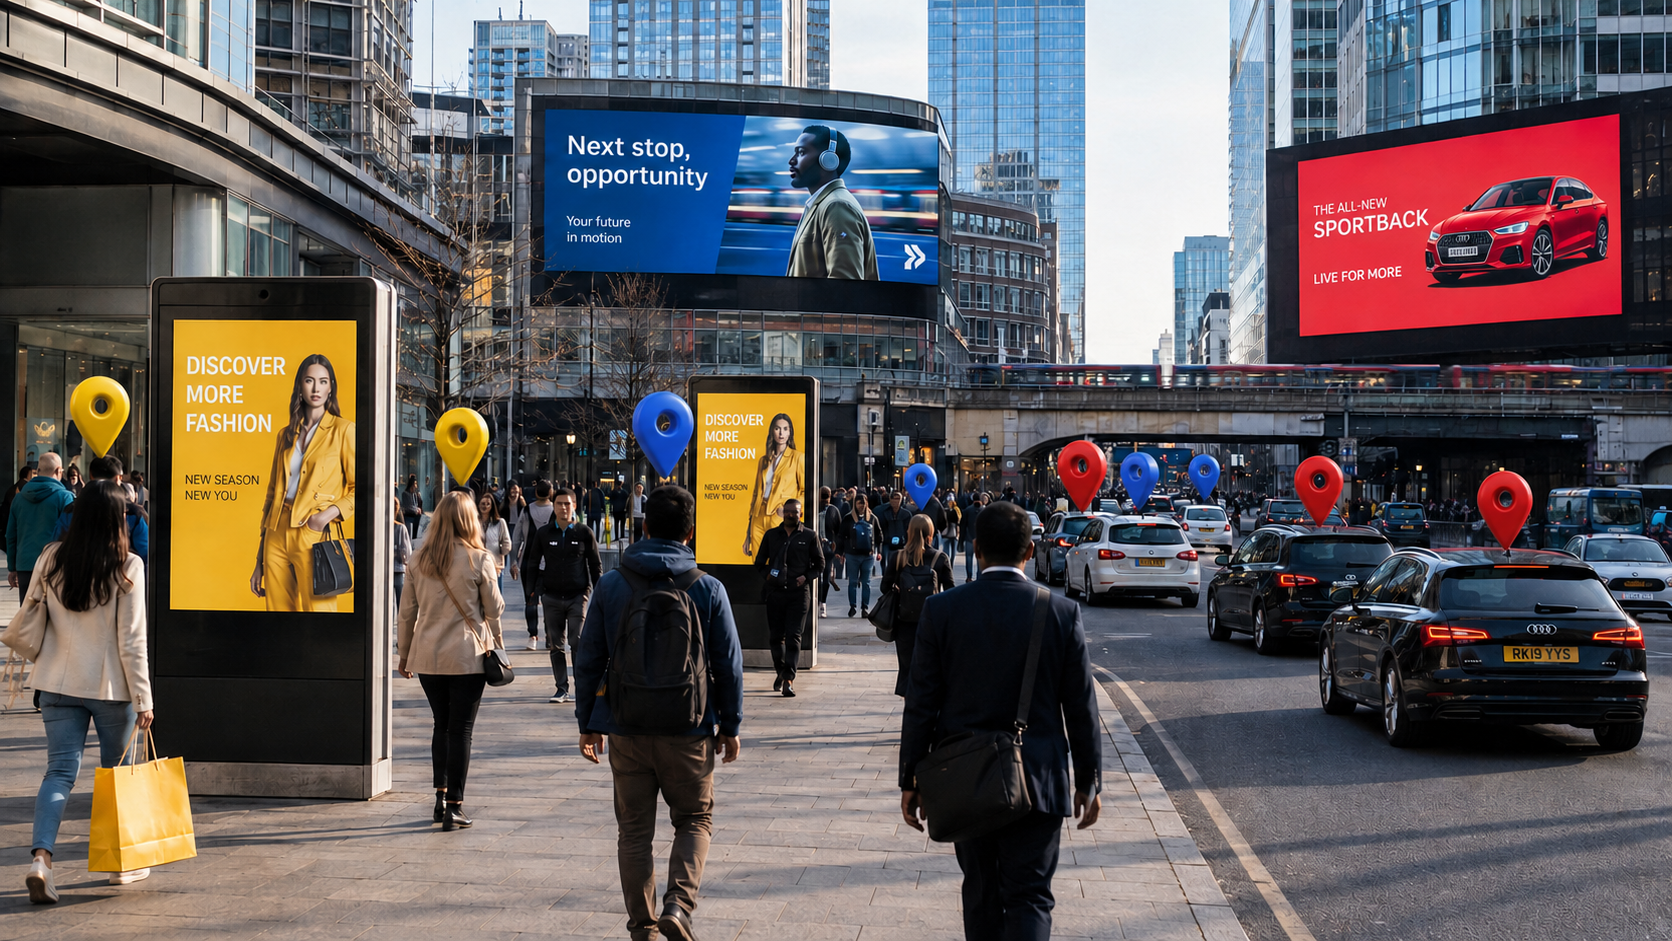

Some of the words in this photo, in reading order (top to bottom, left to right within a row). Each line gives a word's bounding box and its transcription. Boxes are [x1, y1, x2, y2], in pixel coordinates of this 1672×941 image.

[568, 135, 624, 157] Next
[631, 139, 690, 163] stop,
[567, 166, 709, 192] opportunity
[1313, 203, 1335, 216] THE
[1337, 197, 1389, 214] ALL-NEW
[566, 215, 594, 228] Your
[596, 216, 631, 228] future
[1313, 208, 1430, 239] SPORTBACK
[567, 231, 578, 243] in
[581, 232, 622, 244] motion
[1313, 272, 1339, 285] LIVE
[1342, 269, 1365, 282] FOR
[1368, 266, 1403, 280] MORE
[186, 356, 286, 376] DISCOVER
[186, 385, 244, 404] MORE
[186, 414, 272, 433] FASHION
[705, 413, 764, 426] DISCOVER
[705, 430, 739, 443] MORE
[704, 447, 756, 460] FASHION
[185, 474, 212, 486] NEW
[214, 474, 260, 486] SEASON
[704, 483, 720, 491] NEW
[720, 483, 748, 491] SEASON
[185, 490, 212, 502] NEW
[214, 490, 238, 502] YOU
[704, 492, 720, 500] NEW
[722, 493, 736, 501] YOU
[1513, 647, 1542, 661] RK19
[1545, 647, 1572, 661] YYS
